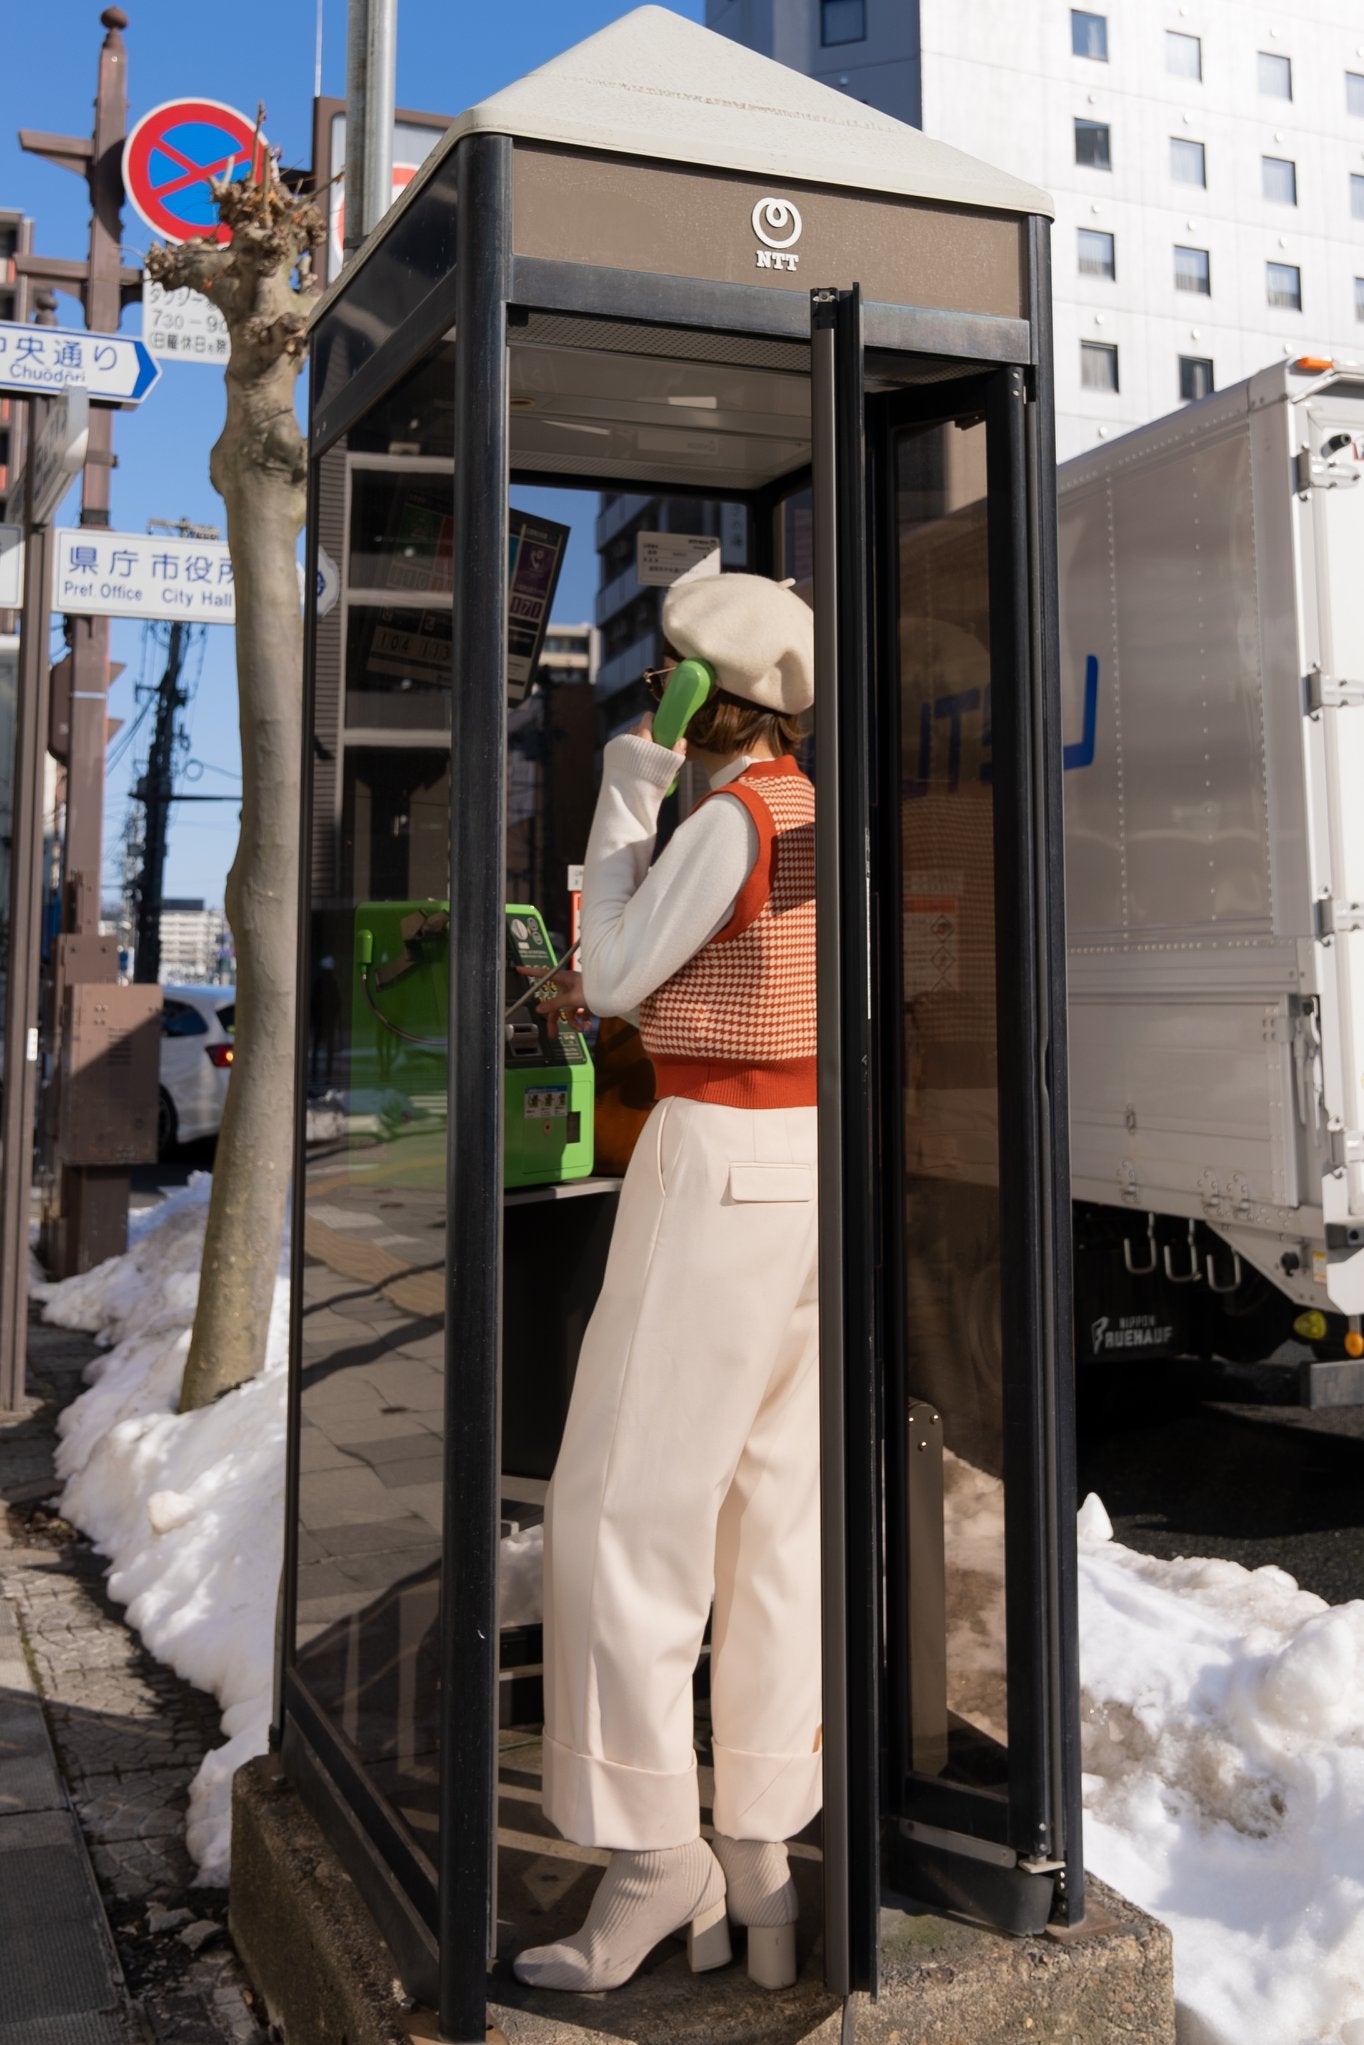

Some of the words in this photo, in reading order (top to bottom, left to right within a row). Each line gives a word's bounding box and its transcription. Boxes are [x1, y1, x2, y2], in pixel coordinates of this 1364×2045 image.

[756, 250, 799, 271] NTT
[100, 583, 143, 601] Office
[162, 588, 194, 608] City
[202, 592, 232, 607] Hall
